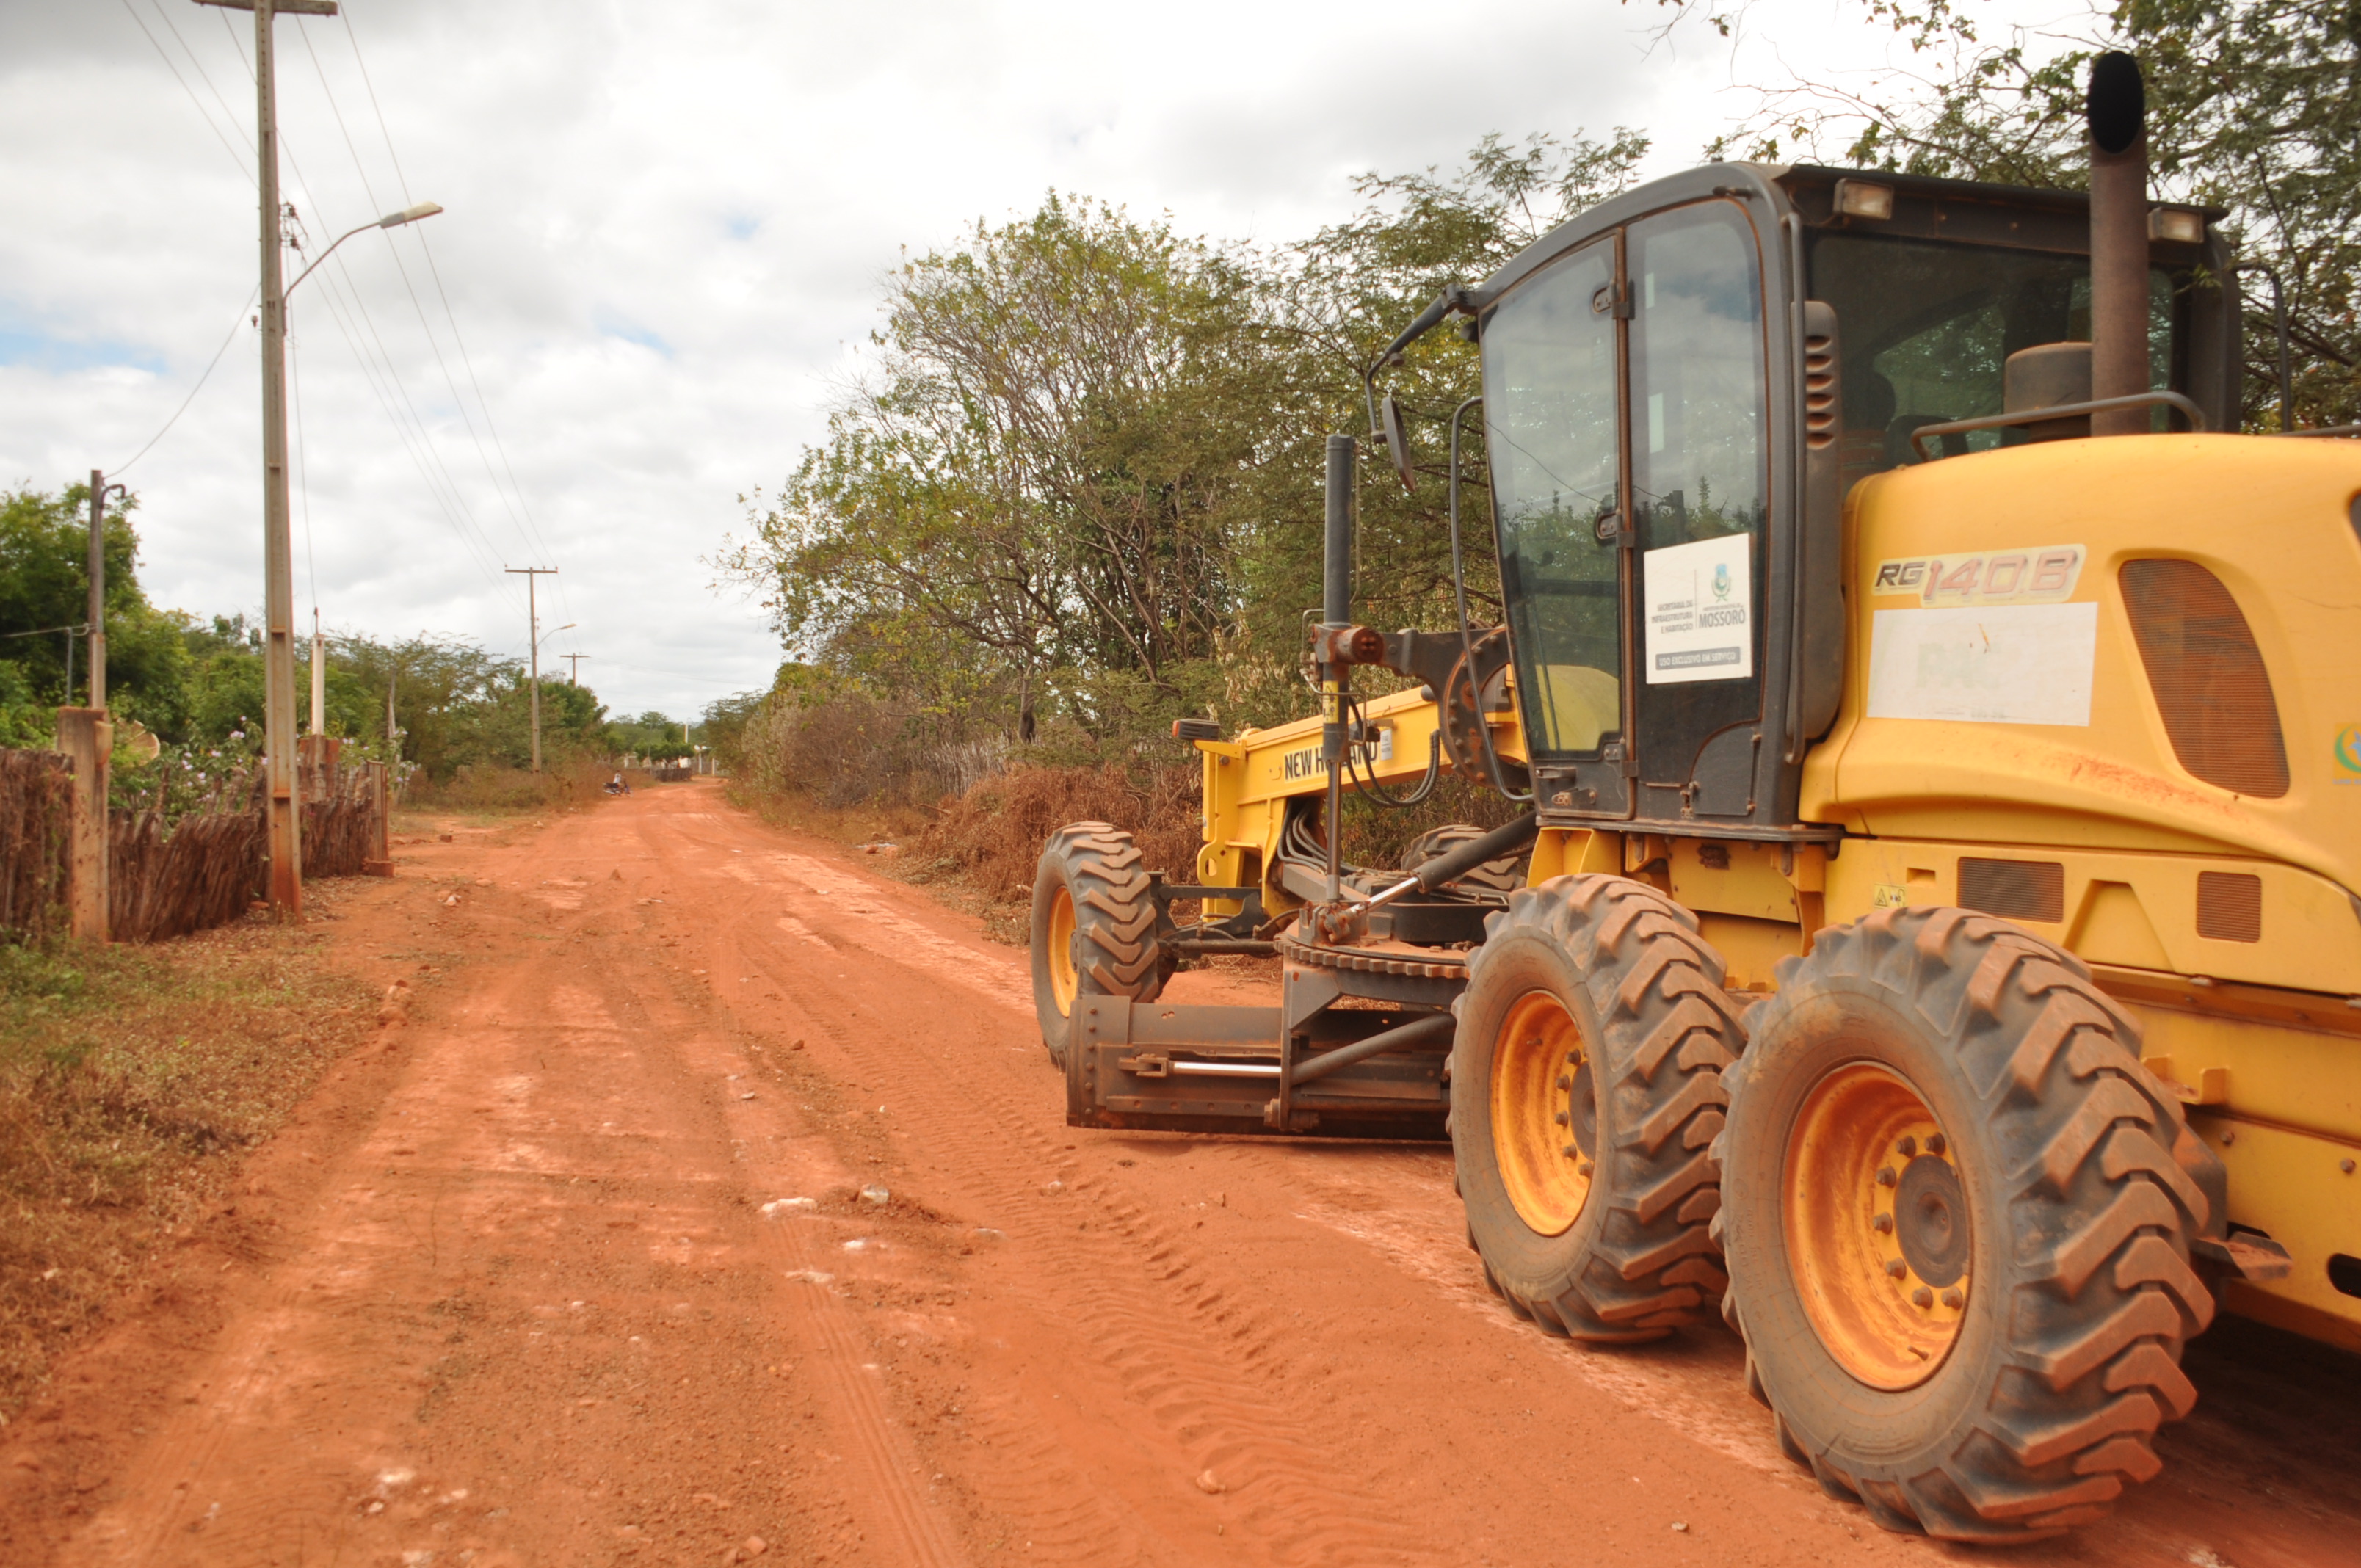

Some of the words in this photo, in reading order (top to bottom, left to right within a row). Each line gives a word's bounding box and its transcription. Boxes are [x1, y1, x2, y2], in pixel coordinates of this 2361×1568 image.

[1875, 562, 1924, 587] RG
[1699, 606, 1745, 628] MOSSORÓ
[1659, 656, 1671, 667] USO
[1672, 653, 1701, 665] EXCLUSIVO
[1702, 653, 1711, 663] EM
[1712, 651, 1737, 663] SERVIÇO
[1285, 749, 1312, 780] NEW
